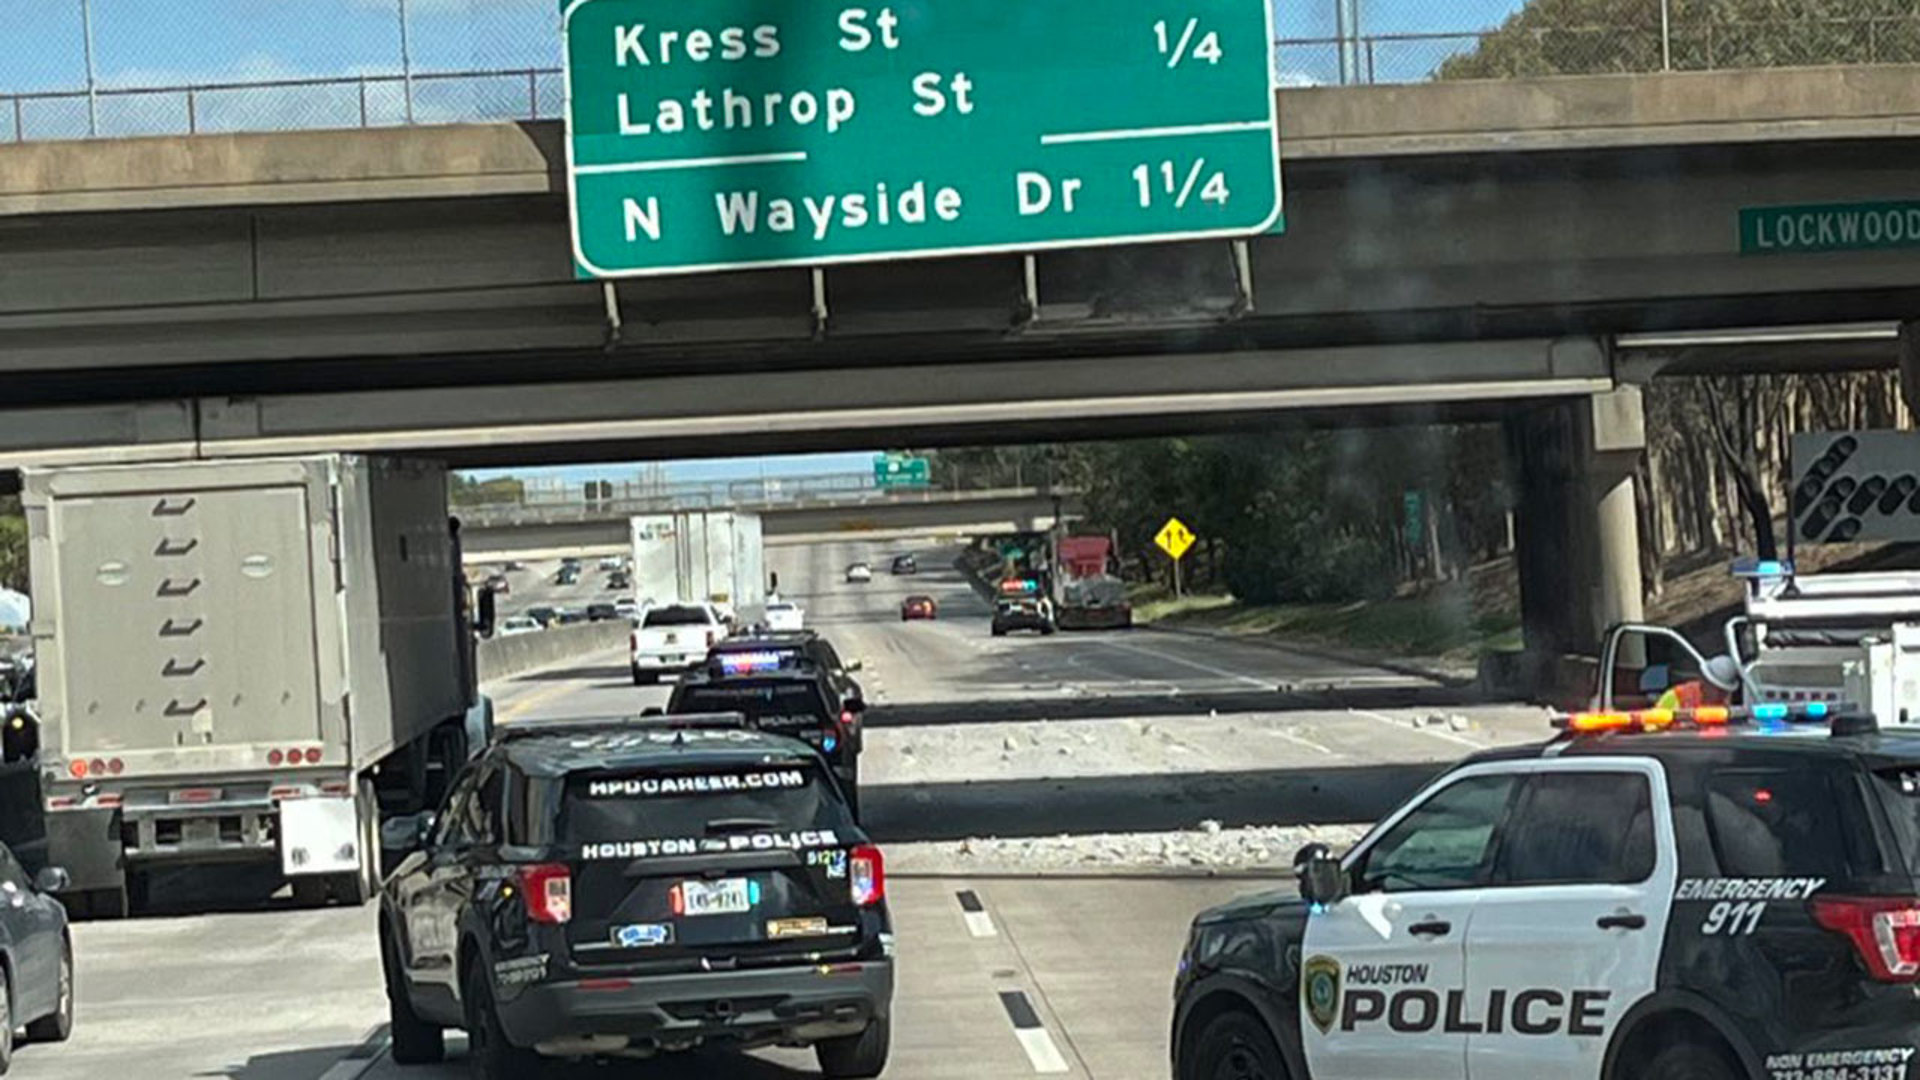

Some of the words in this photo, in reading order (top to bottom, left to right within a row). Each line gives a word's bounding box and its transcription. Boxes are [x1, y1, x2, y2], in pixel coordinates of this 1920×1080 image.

[615, 22, 781, 66] Kress
[838, 7, 899, 51] St
[618, 86, 856, 136] Lathrop
[912, 72, 974, 117] St
[624, 197, 661, 241] N
[716, 181, 962, 240] Wayside
[1017, 172, 1082, 216] Dr
[1756, 209, 1920, 248] LOCKWOOD
[582, 838, 697, 860] HOUSTON
[729, 829, 838, 851] POLICE
[1675, 878, 1827, 900] EMERGENCY
[1701, 901, 1767, 935] 911
[1346, 963, 1429, 985] HOUSTON
[1341, 989, 1612, 1036] POLICE
[1766, 1054, 1803, 1069] NON
[1806, 1047, 1915, 1068] EMERGENCY
